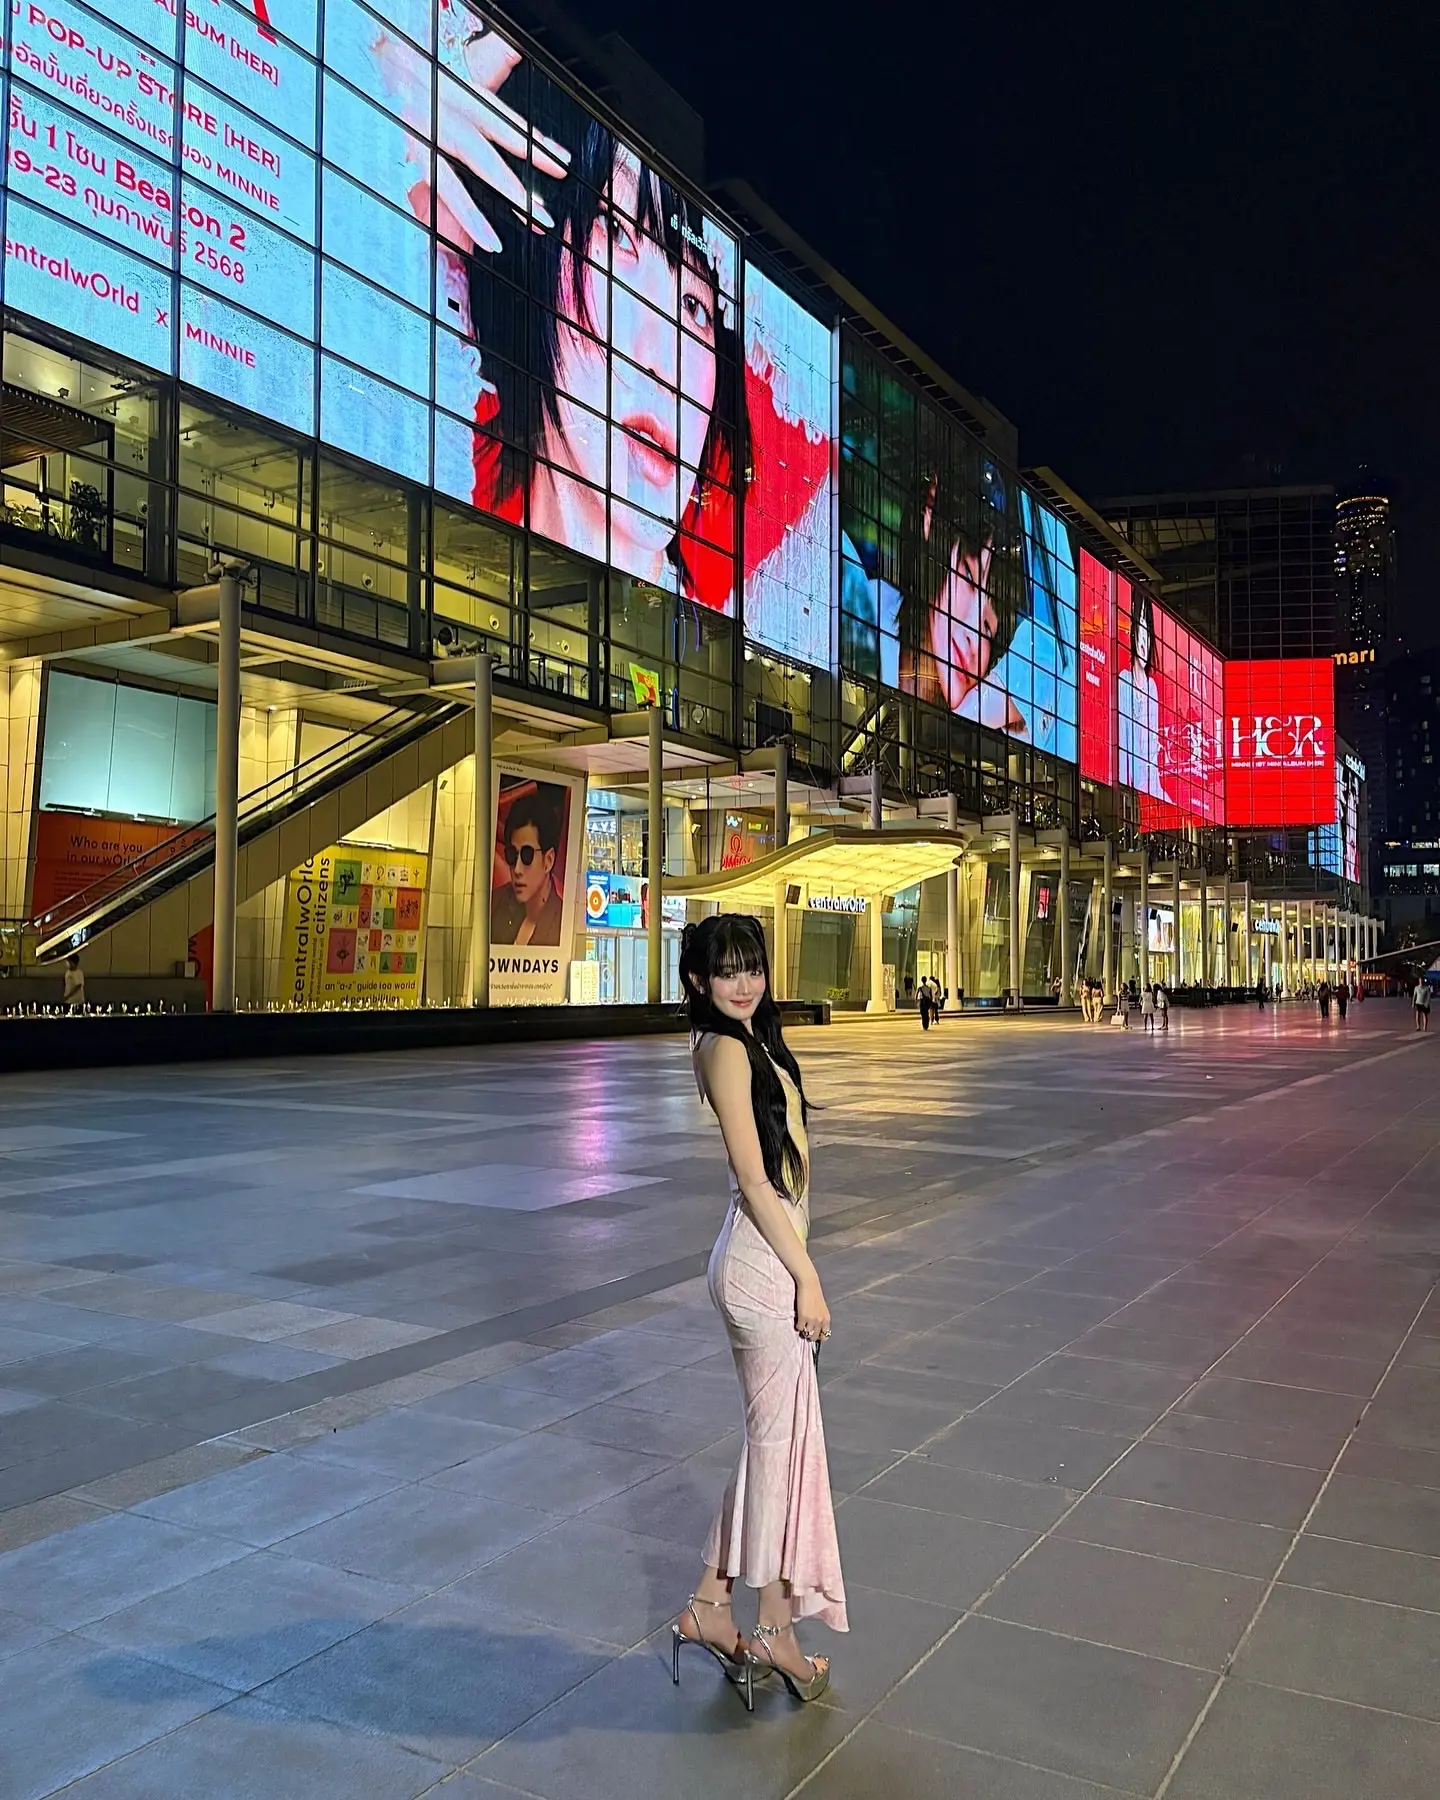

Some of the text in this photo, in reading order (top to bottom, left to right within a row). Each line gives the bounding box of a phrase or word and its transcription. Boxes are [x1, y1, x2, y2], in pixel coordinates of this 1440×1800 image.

[28, 3, 281, 178] POP-UP STORE [HER]
[230, 36, 278, 87] [HER]
[8, 145, 77, 197] 9-23
[194, 240, 244, 283] 2568
[45, 124, 57, 152] 1
[229, 223, 246, 252] 2
[217, 162, 280, 212] MINNIE
[5, 238, 139, 314] entralwOrld
[185, 322, 257, 368] MINNIE
[70, 835, 143, 854] Who are you
[80, 854, 100, 865] our
[313, 858, 330, 935] citizens
[357, 981, 378, 992] guide
[394, 980, 416, 990] world
